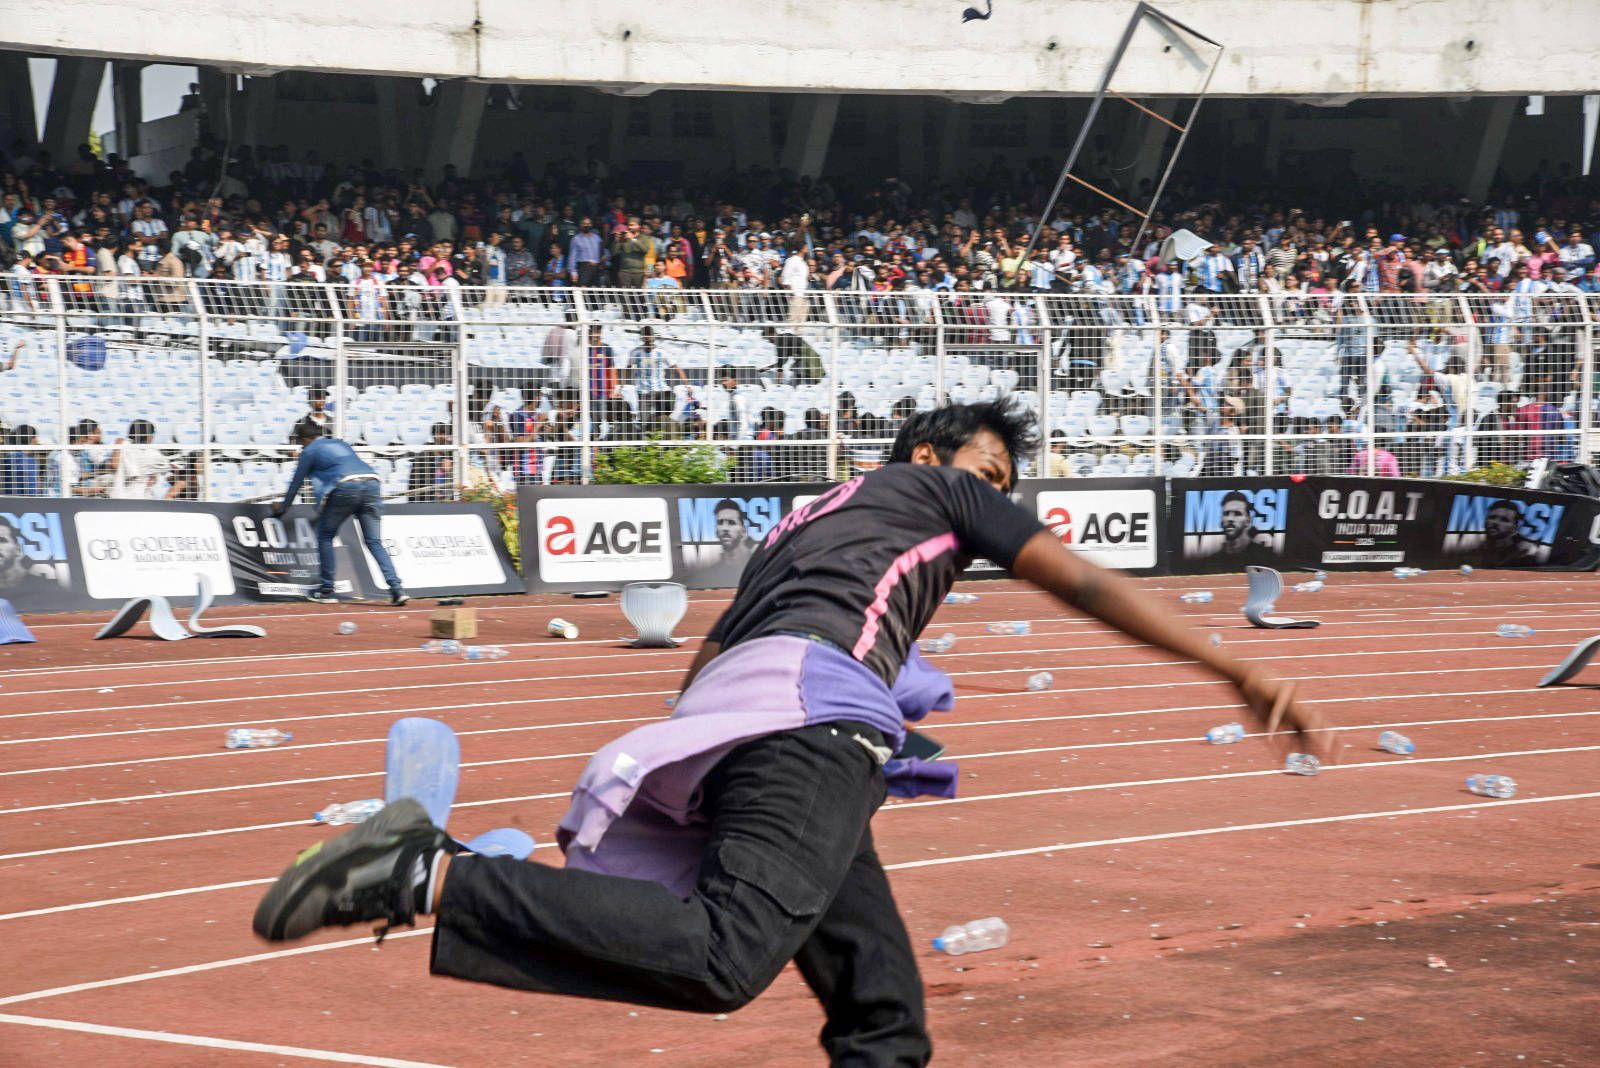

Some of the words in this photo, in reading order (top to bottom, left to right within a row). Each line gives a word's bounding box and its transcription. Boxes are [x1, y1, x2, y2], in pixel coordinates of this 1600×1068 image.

[678, 497, 781, 542] MSI
[1184, 489, 1288, 532] MSI
[1318, 489, 1424, 520] G.O.A.T
[1447, 495, 1565, 544] MSI
[232, 516, 343, 548] G.O.A
[583, 521, 661, 554] ACE
[1080, 512, 1149, 544] ACE
